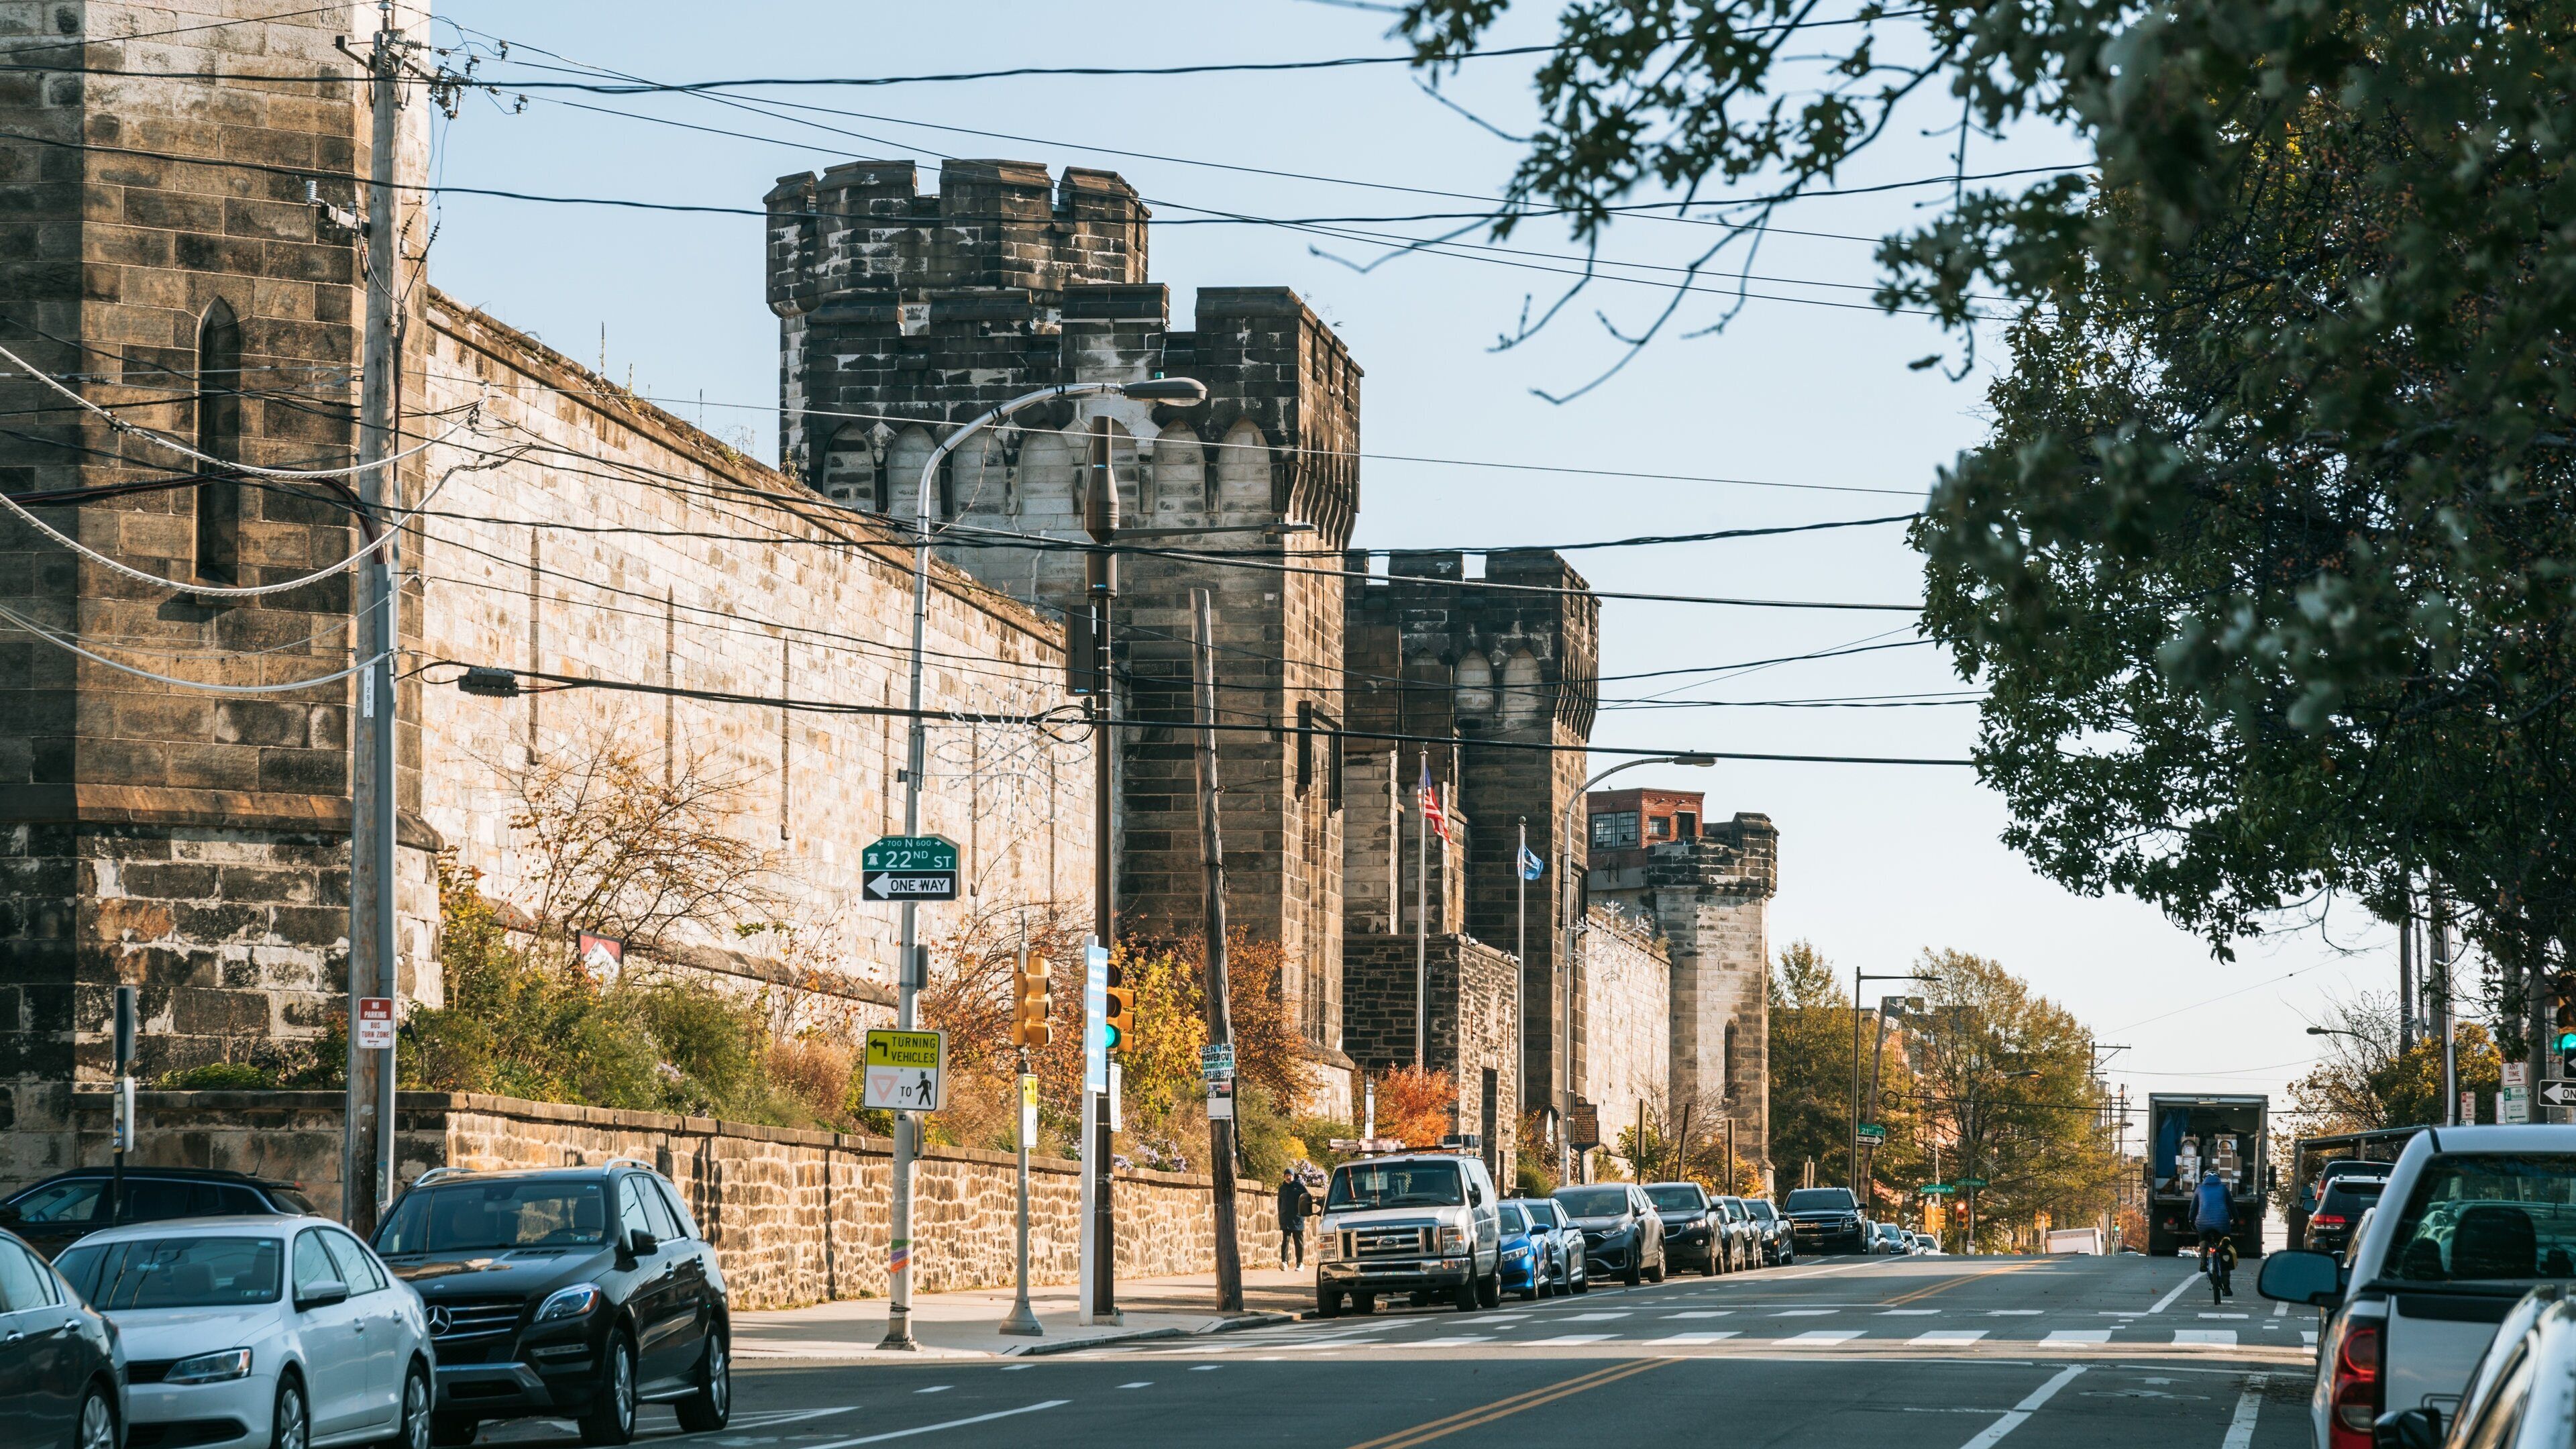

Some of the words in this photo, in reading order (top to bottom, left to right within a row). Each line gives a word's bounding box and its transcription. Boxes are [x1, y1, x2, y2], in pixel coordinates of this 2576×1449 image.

[905, 839, 913, 847] N
[916, 839, 932, 847] 600
[885, 851, 928, 868] 22ND
[934, 856, 952, 867] ST
[891, 879, 916, 892] ONE
[920, 879, 947, 892] WAY
[372, 1002, 380, 1010] NO
[364, 1011, 387, 1019] PARKING
[892, 1036, 936, 1049] TURNING
[1202, 1045, 1216, 1054] BEN
[891, 1051, 935, 1063] VEHICLES
[1201, 1053, 1221, 1063] MOVER
[1221, 1053, 1232, 1061] GUY
[900, 1086, 912, 1097] TO
[2505, 1089, 2510, 1099] 2
